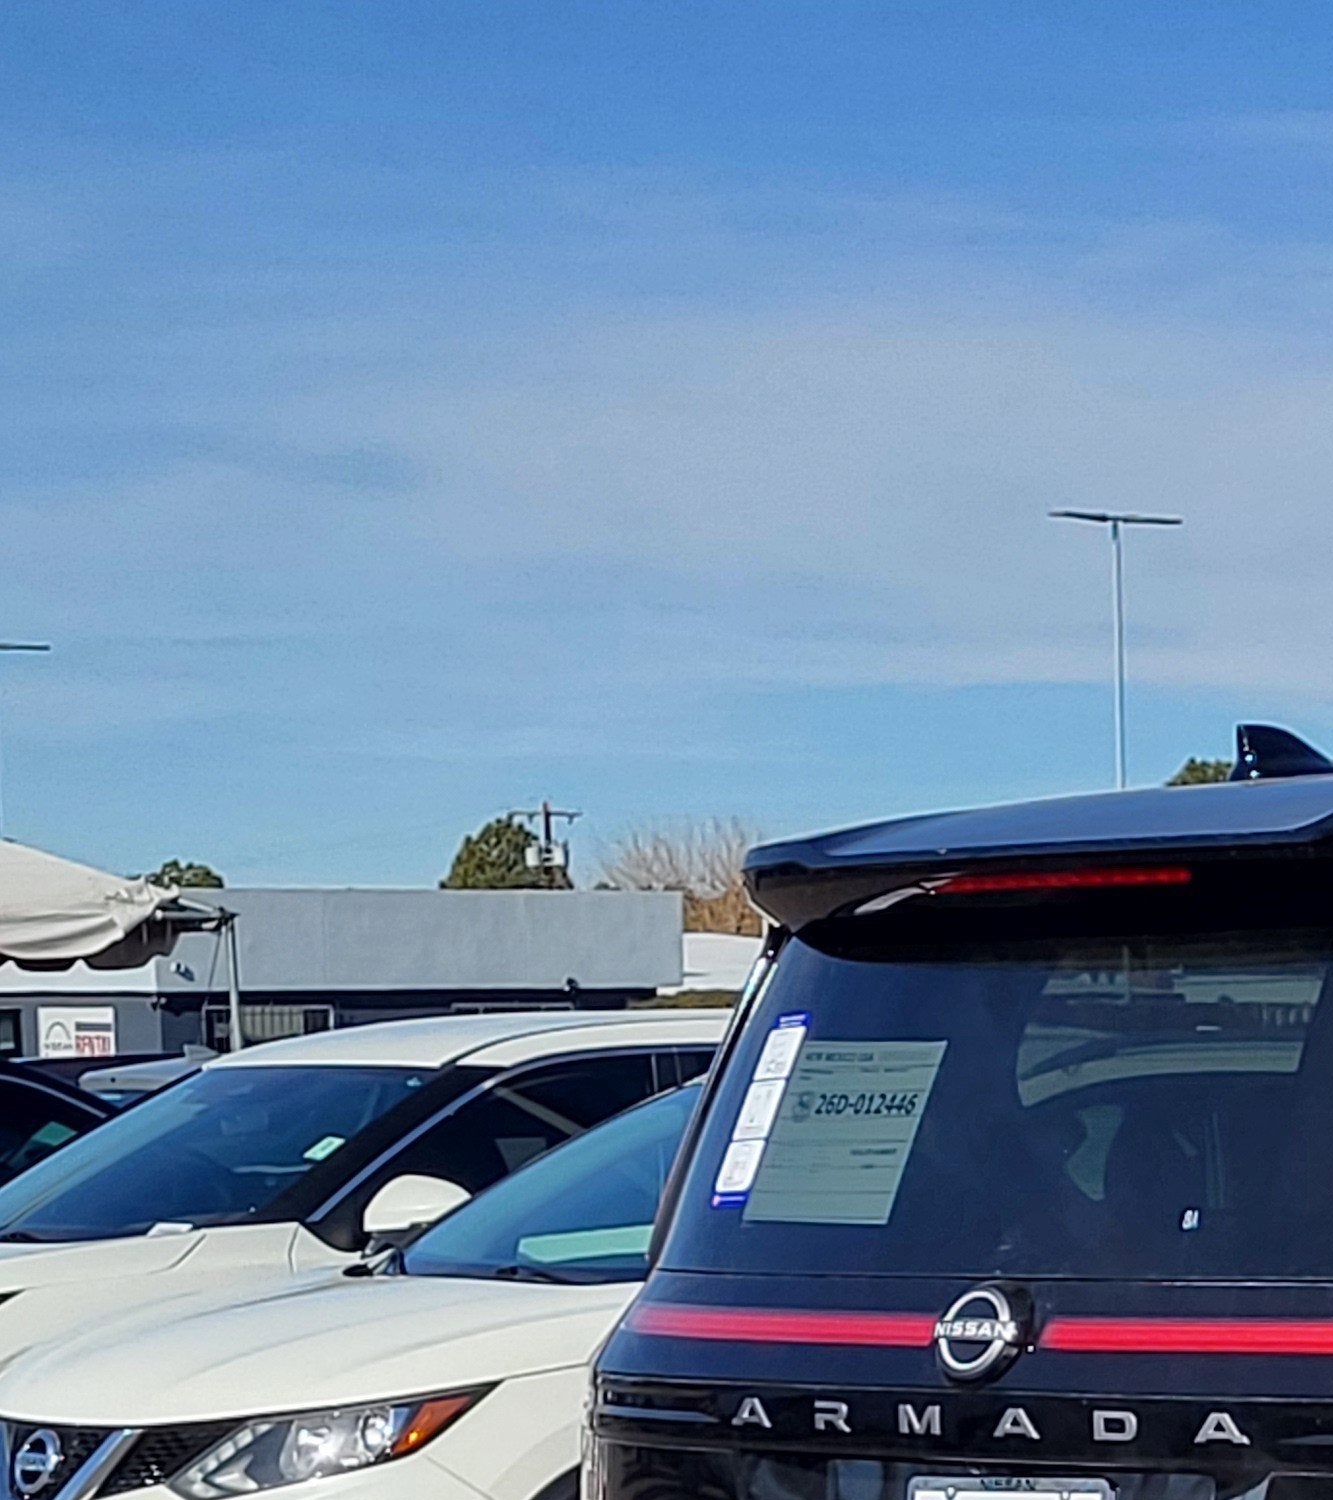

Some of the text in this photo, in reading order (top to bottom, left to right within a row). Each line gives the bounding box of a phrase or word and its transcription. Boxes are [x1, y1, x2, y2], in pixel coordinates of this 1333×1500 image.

[814, 1092, 918, 1115] 26D-012446
[934, 1321, 1017, 1341] NISSAN
[731, 1397, 1250, 1446] ARMADA
